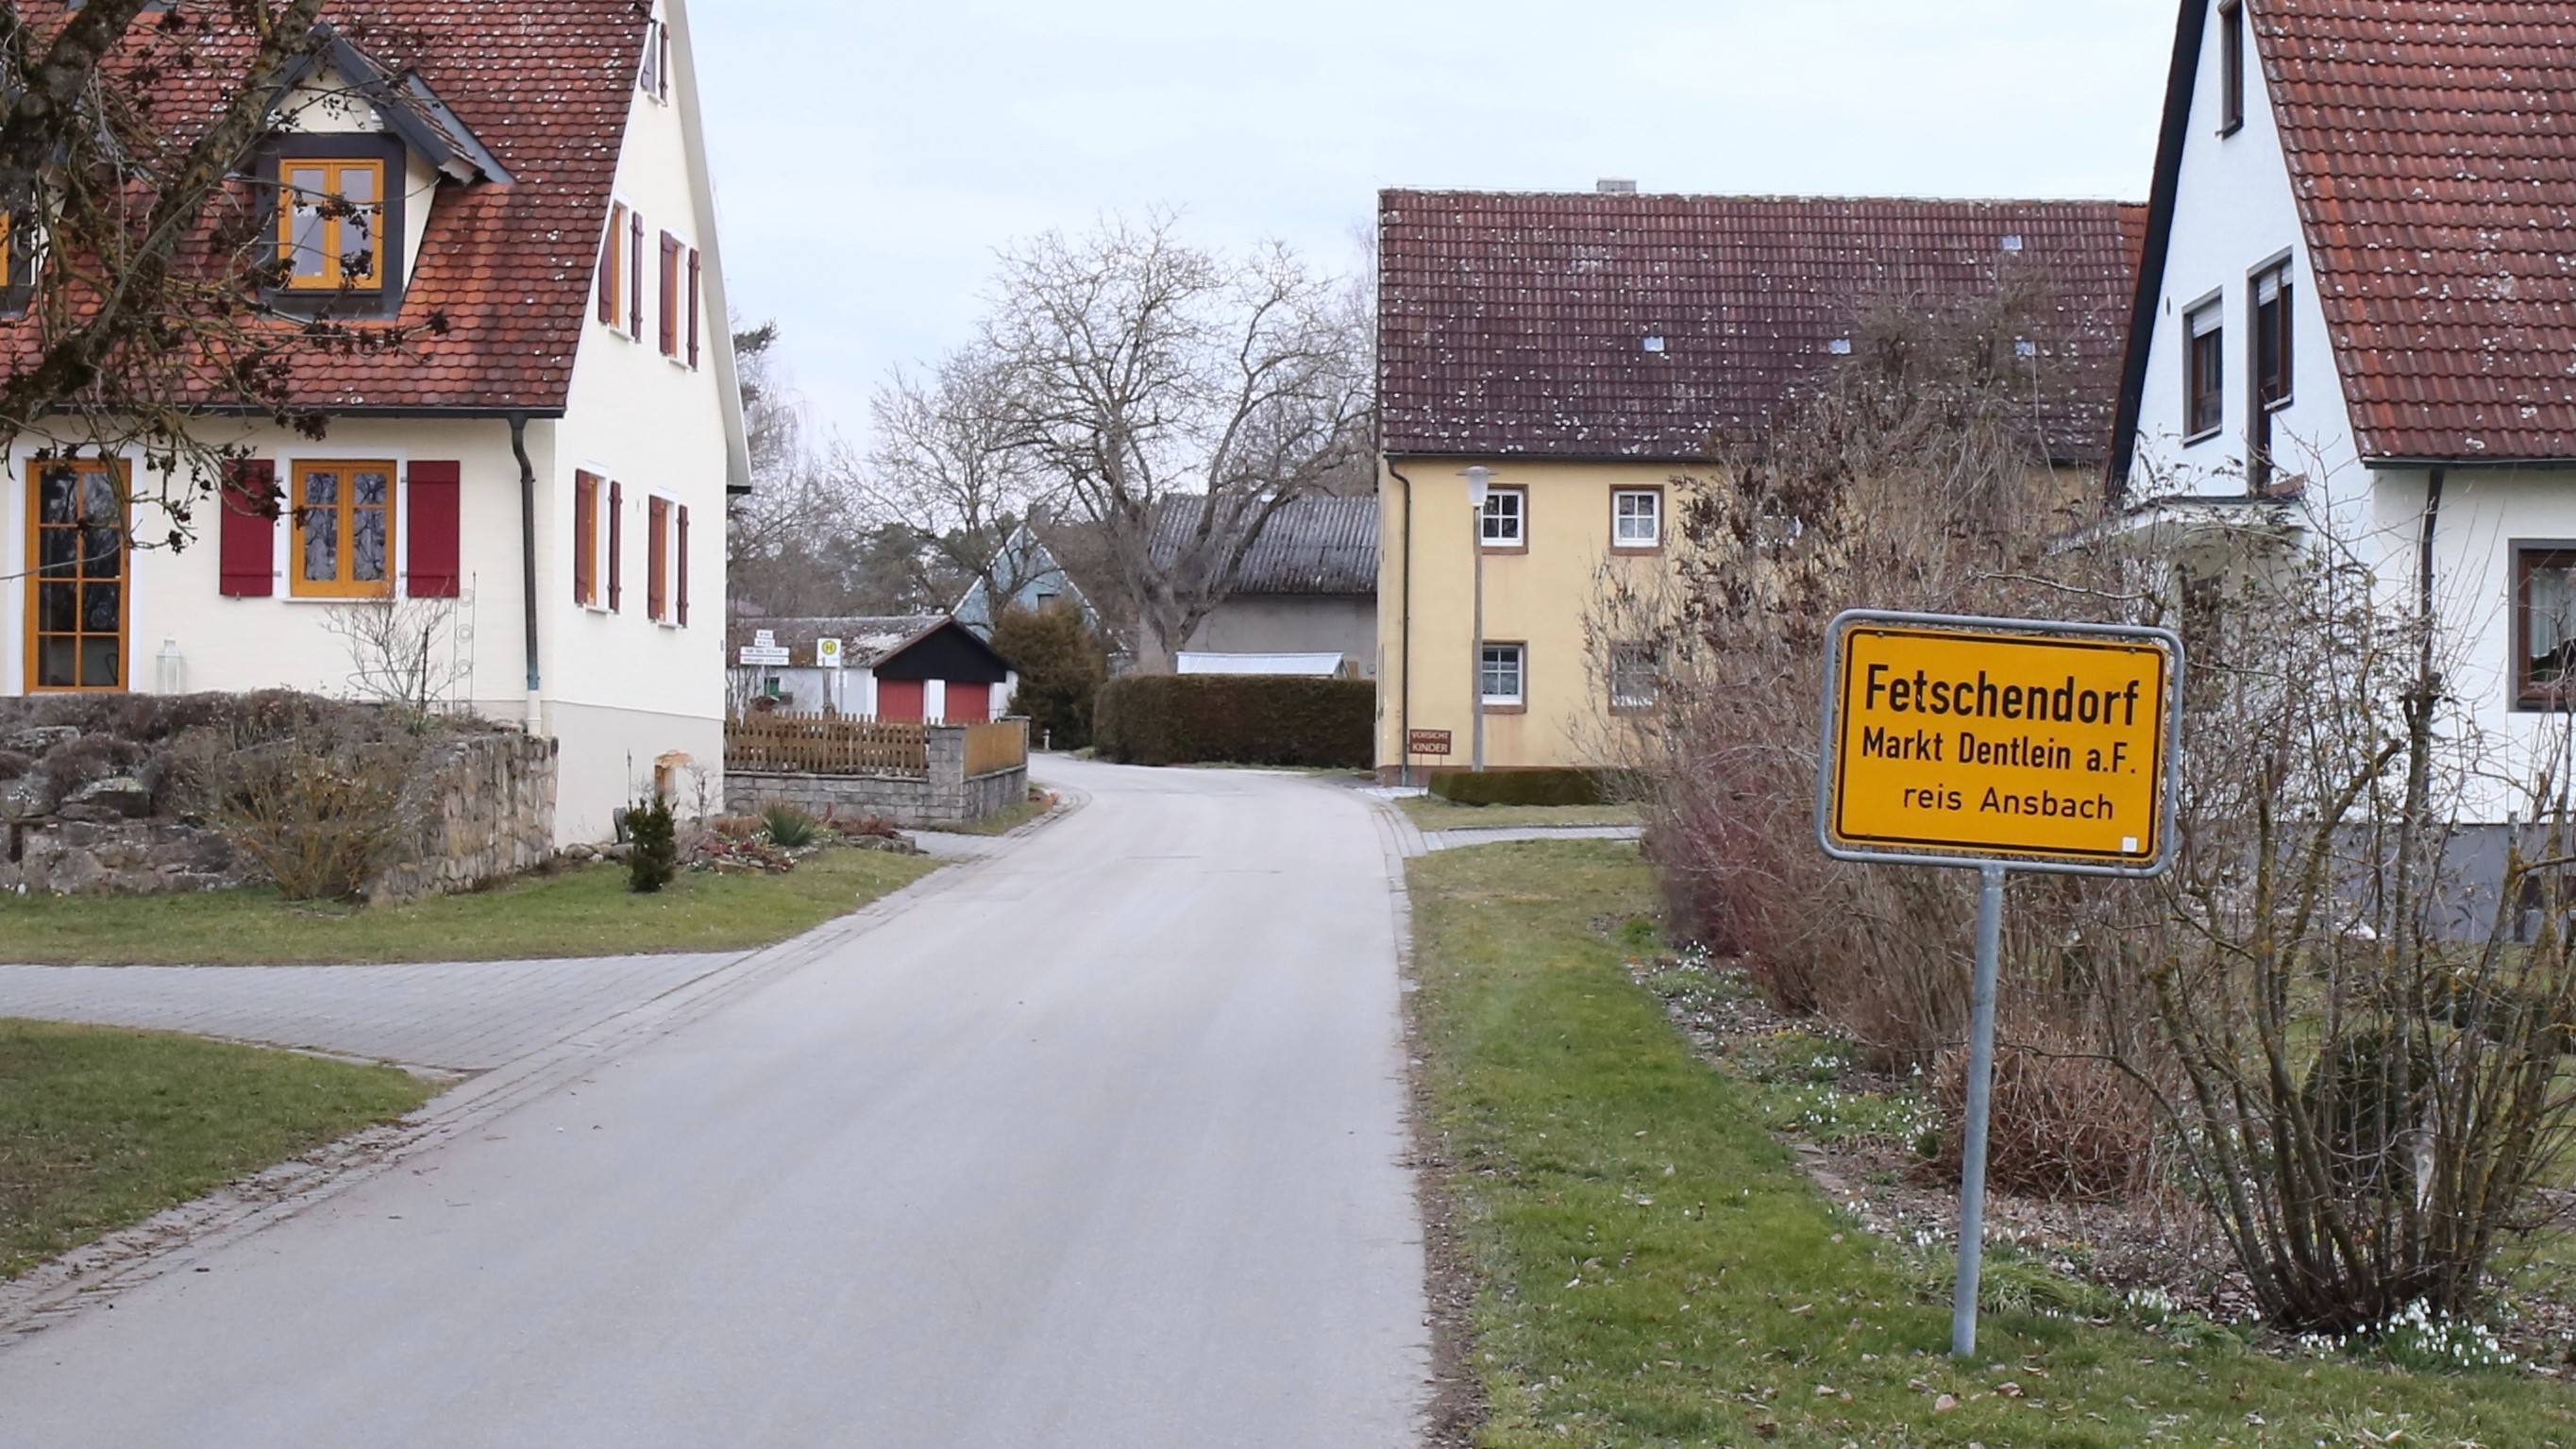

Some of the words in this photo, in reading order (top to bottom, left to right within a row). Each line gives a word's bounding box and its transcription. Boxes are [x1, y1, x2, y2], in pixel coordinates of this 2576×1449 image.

[1865, 664, 2140, 726] Fetschendorf
[1411, 742, 1449, 753] KINDER
[1862, 725, 1944, 762] Markt
[1958, 732, 2071, 770] Dentlein
[2086, 742, 2137, 774] a.F.
[1979, 786, 2113, 820] Ansbach
